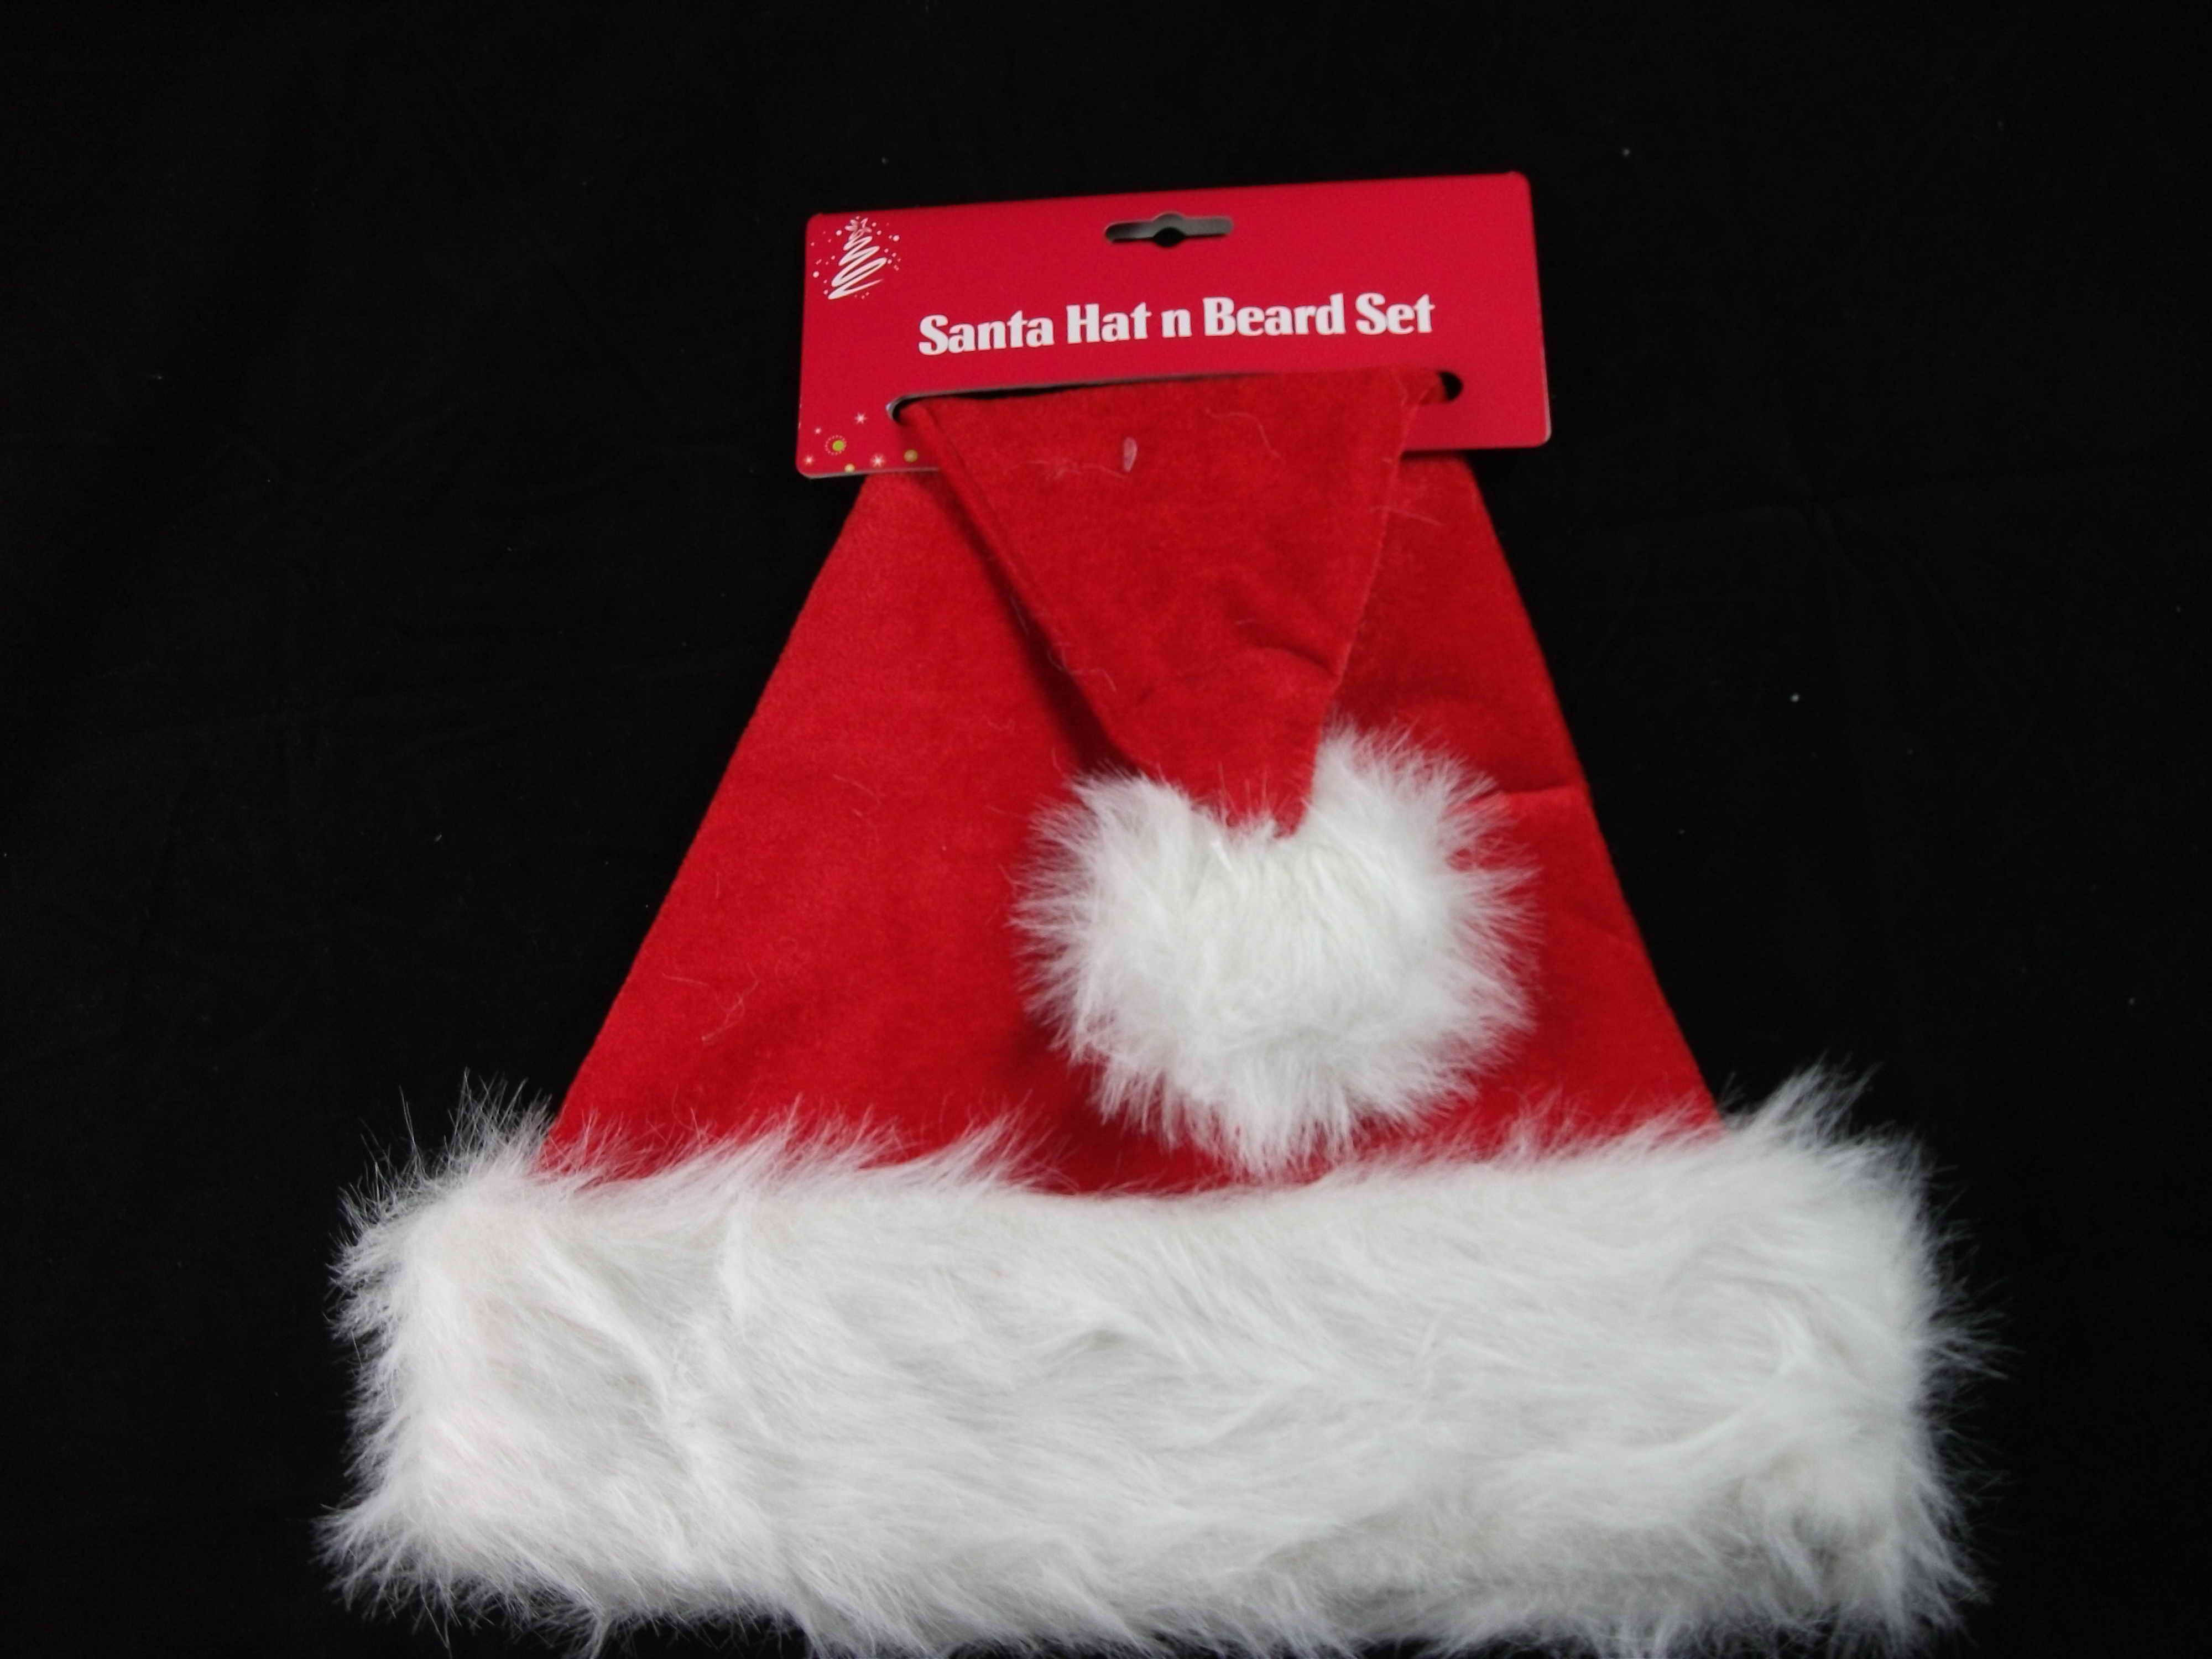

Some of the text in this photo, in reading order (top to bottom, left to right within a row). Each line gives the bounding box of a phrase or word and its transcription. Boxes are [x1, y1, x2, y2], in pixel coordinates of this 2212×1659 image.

[918, 292, 1435, 356] Santa Hat n Beard Set
